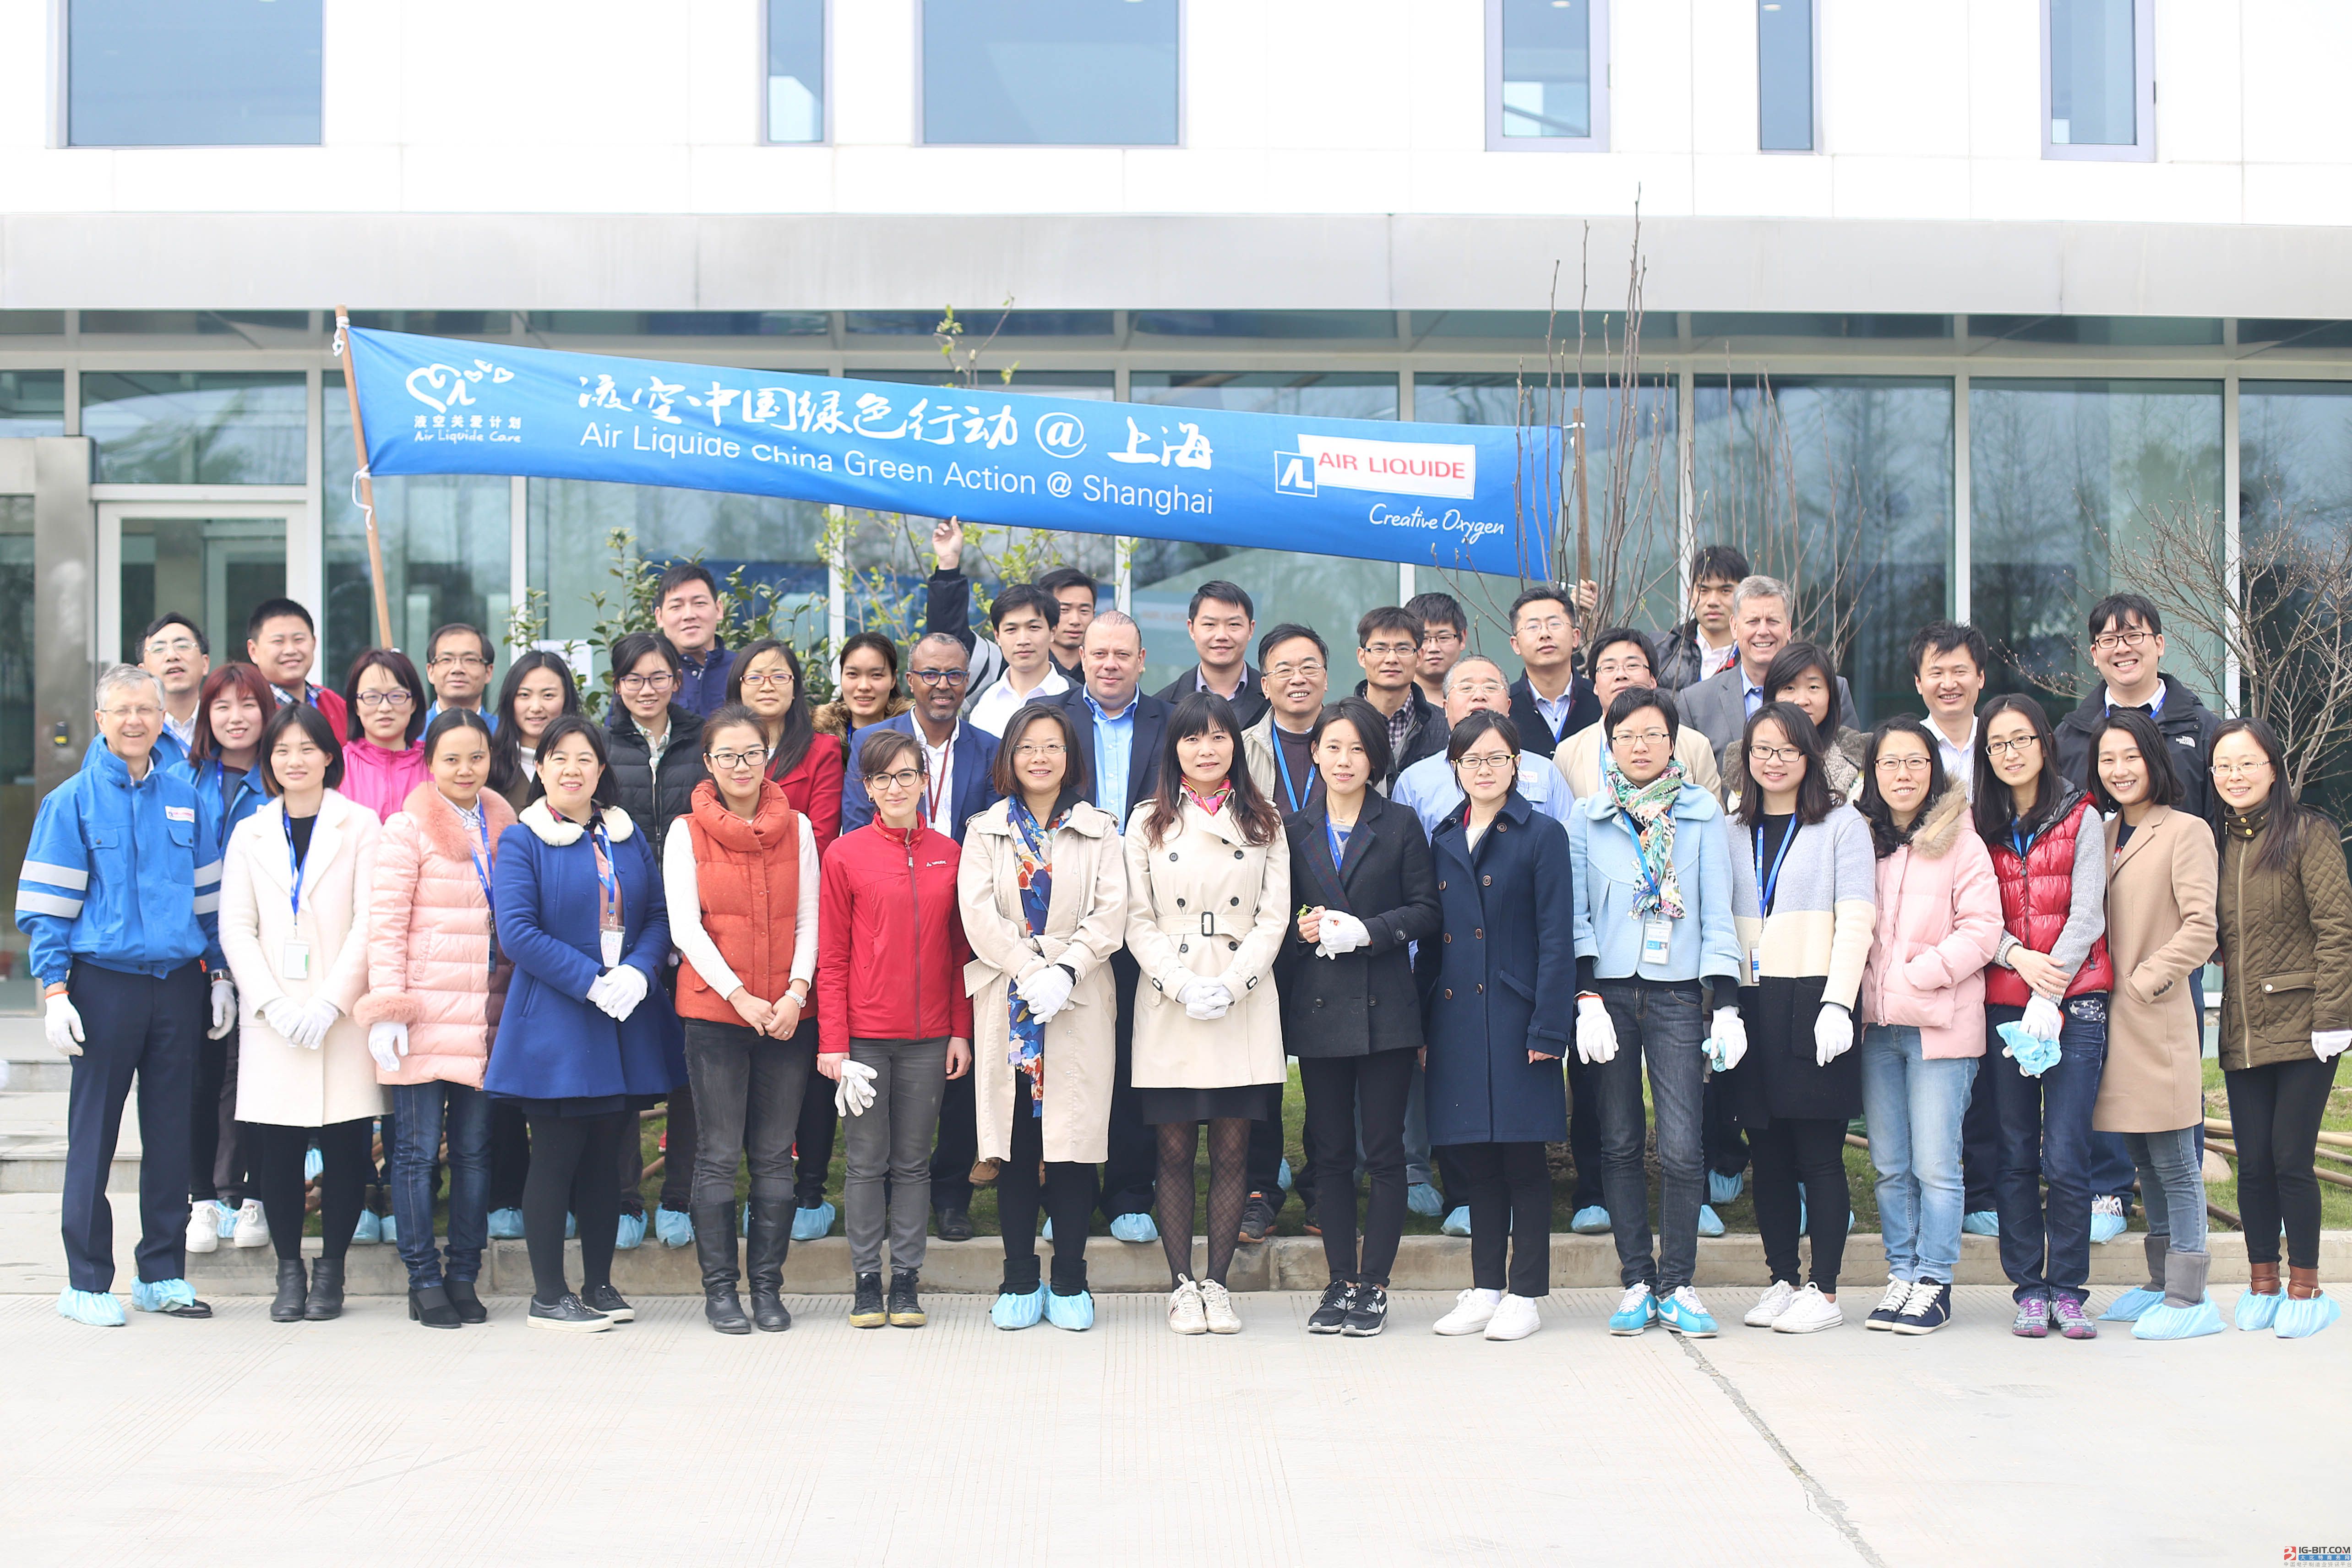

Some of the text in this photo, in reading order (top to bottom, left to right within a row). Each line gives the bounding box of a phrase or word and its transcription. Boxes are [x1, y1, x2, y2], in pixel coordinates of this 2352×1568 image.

[414, 414, 521, 430] 液空关爱计划
[414, 429, 522, 444] Air Liquide Care
[578, 374, 1214, 469] 液空中国绿色行动 @ 上海
[580, 422, 623, 448] Air
[633, 425, 741, 459] Liquide
[844, 450, 933, 484] Green
[943, 461, 1036, 495] Action
[1047, 471, 1073, 498] @
[1083, 475, 1213, 515] Shanghai
[1319, 452, 1465, 479] AIR LIQUIDE
[1369, 503, 1505, 544] Creative Oxygen
